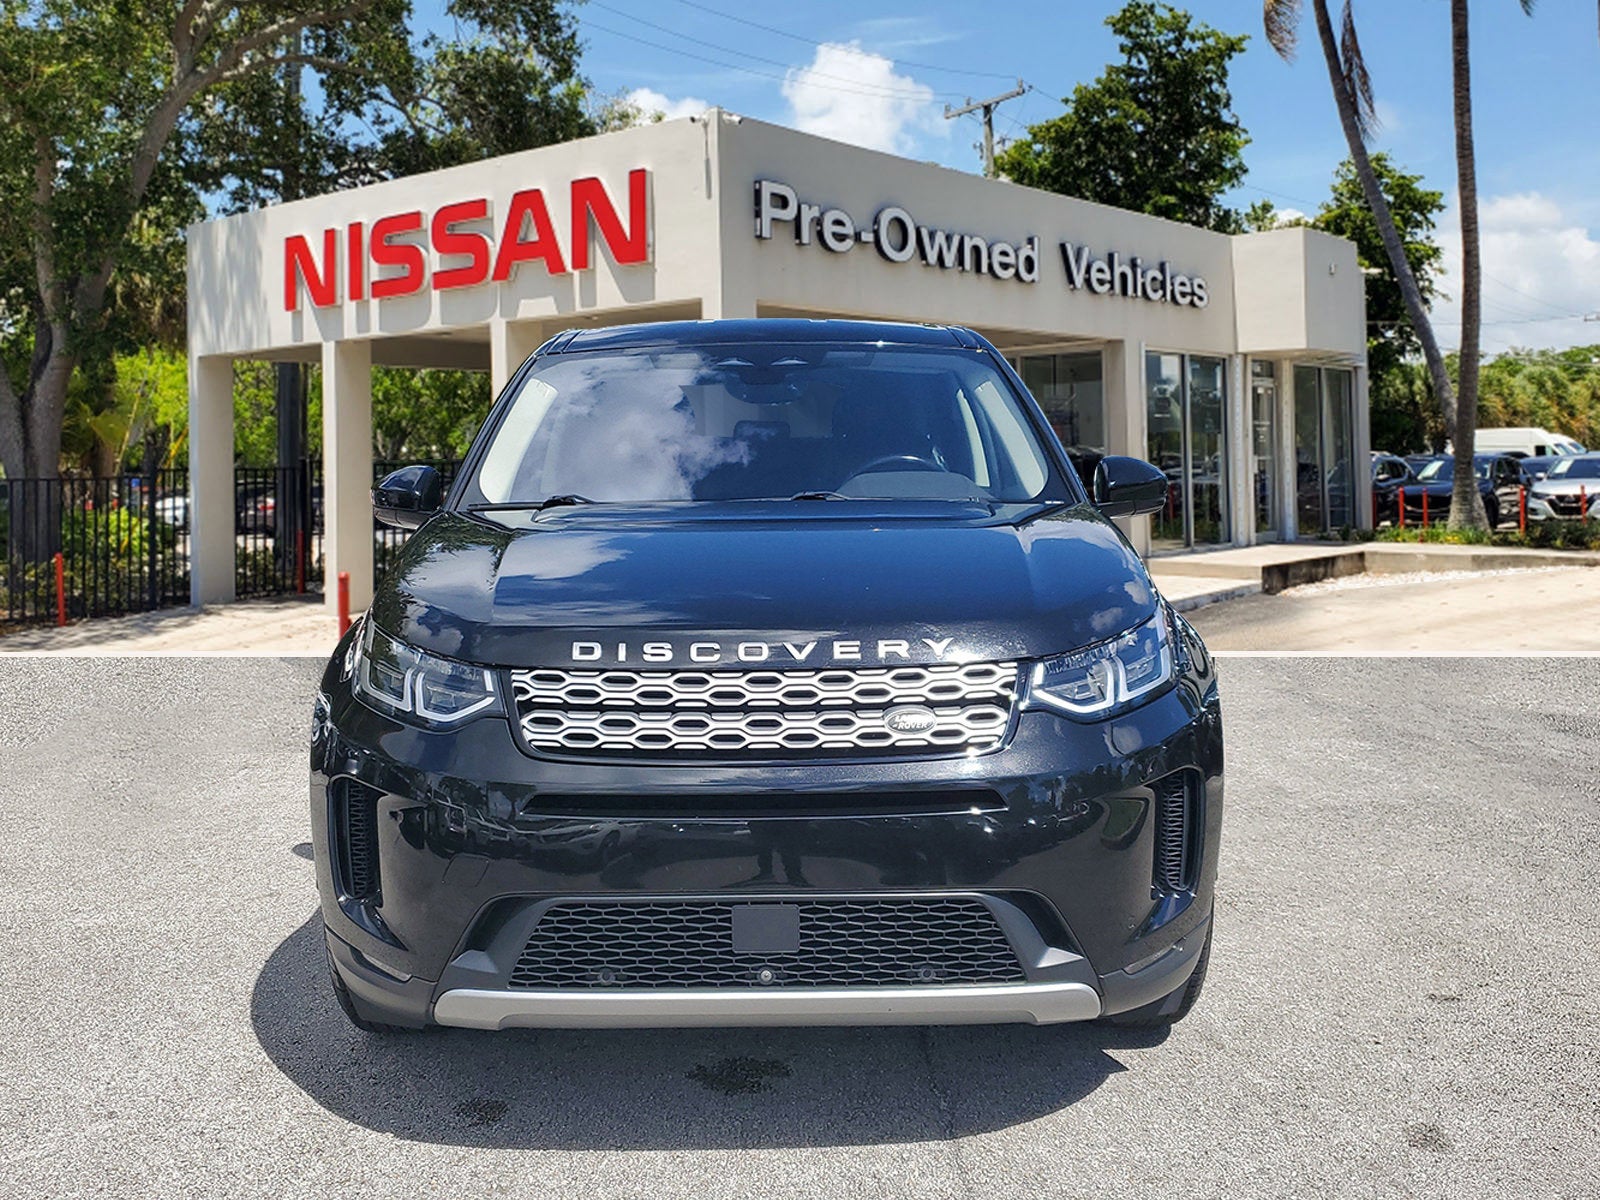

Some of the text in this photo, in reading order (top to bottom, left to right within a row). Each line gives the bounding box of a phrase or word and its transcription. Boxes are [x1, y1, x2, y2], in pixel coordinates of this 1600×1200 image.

[284, 168, 650, 312] NISSAN
[754, 180, 1209, 308] Pre-Owned Vehicles
[572, 638, 954, 663] DISCOVERY
[897, 721, 927, 729] ROVER
